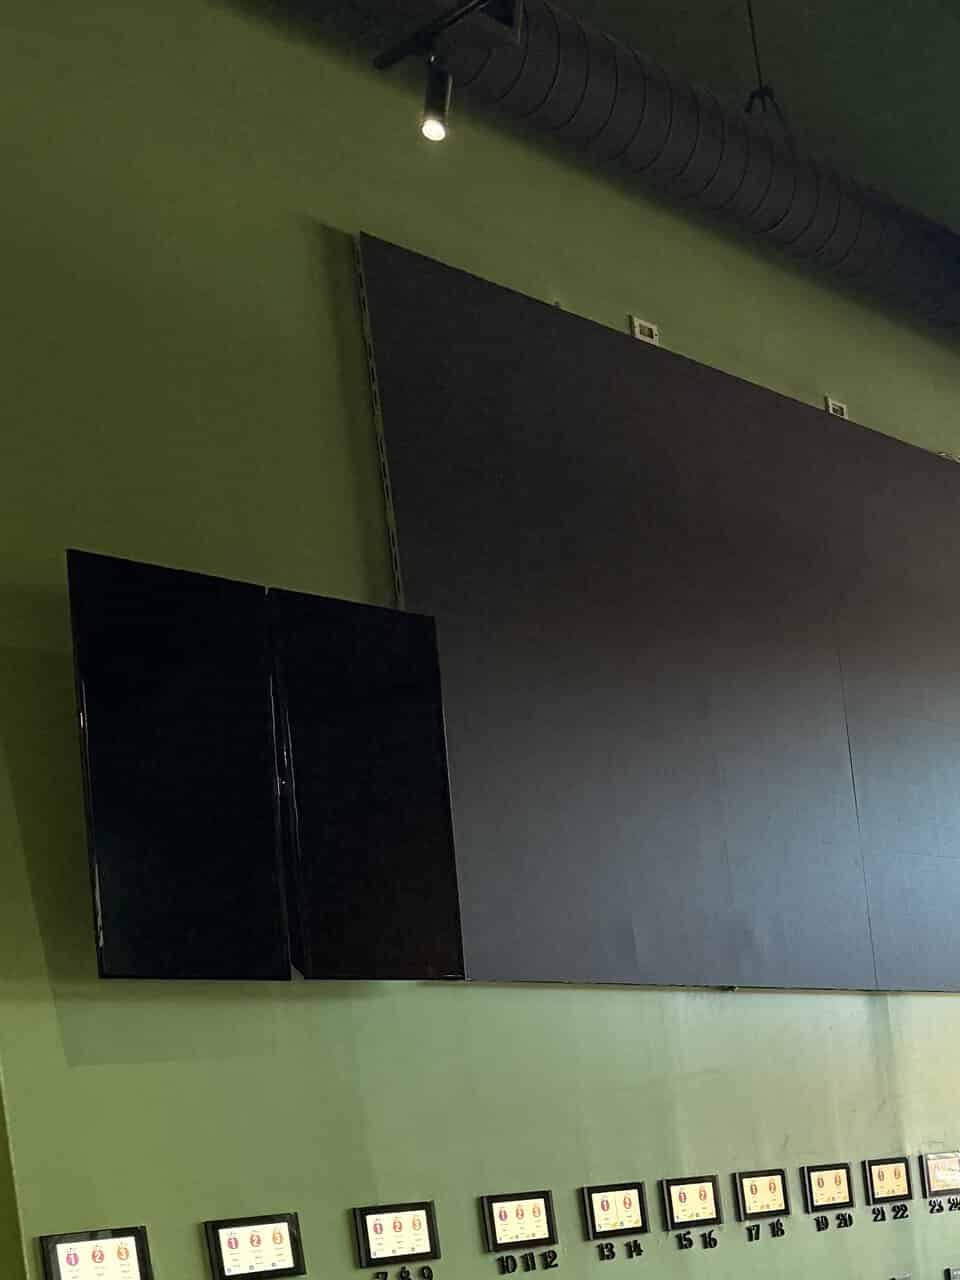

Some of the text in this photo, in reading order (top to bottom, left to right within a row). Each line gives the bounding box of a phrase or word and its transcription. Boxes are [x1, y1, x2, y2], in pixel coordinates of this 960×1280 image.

[872, 1204, 909, 1222] 21 22
[675, 1229, 718, 1249] 15 16
[745, 1223, 760, 1242] 17
[596, 1240, 644, 1261] 13 14
[495, 1249, 559, 1275] 10 11 12
